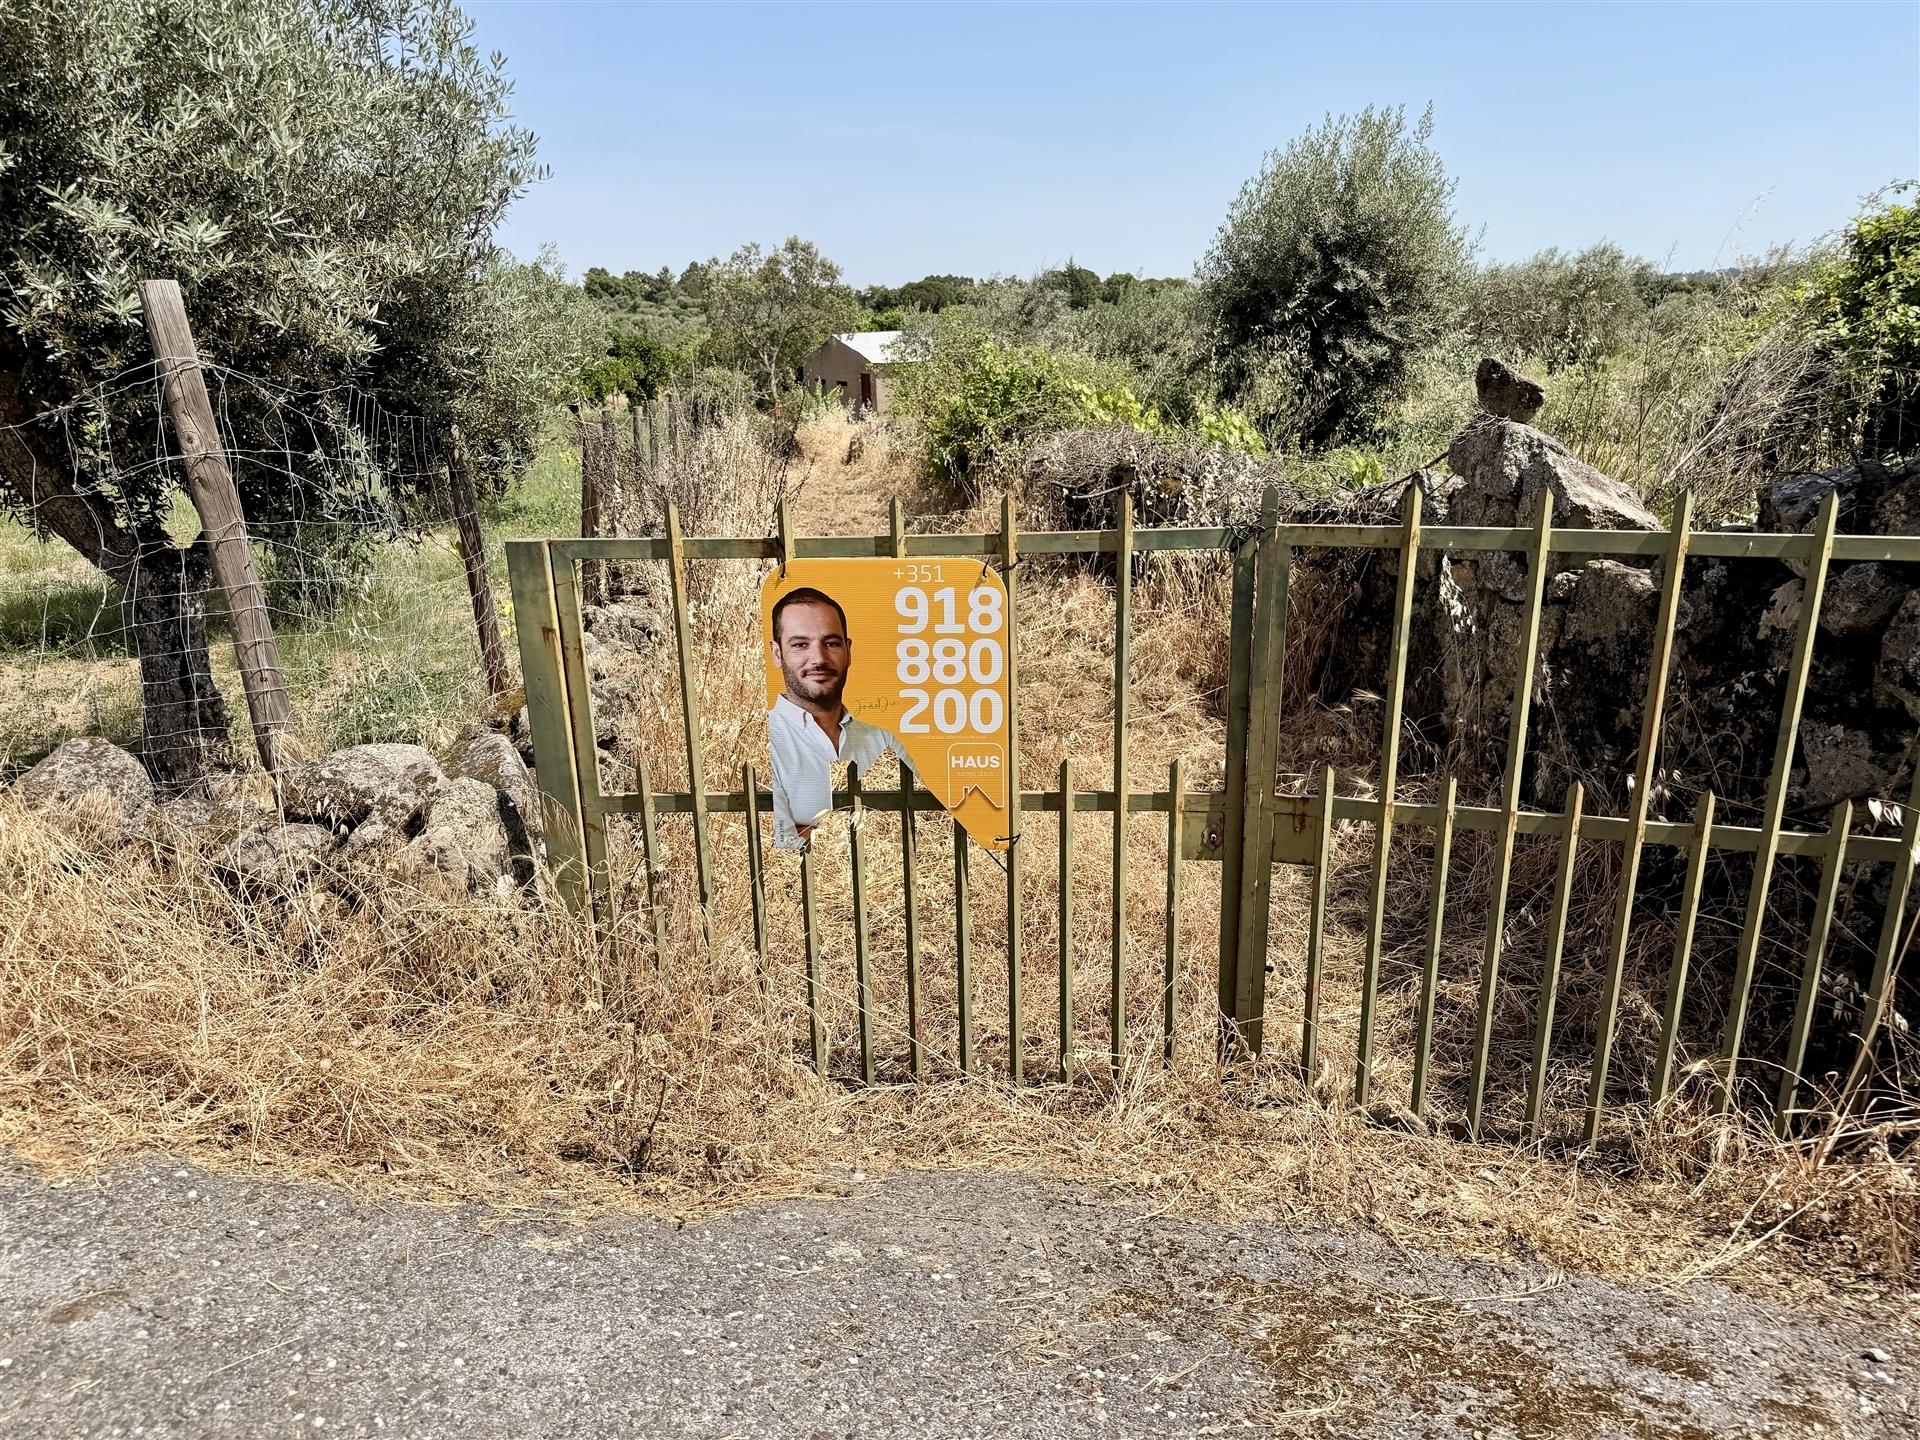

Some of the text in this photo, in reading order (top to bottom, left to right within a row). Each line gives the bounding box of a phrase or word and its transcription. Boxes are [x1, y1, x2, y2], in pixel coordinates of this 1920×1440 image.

[894, 565, 945, 583] +351
[895, 586, 1003, 634] 918
[896, 638, 1003, 685] 880
[899, 688, 1004, 734] 200
[951, 755, 1001, 769] HAUS
